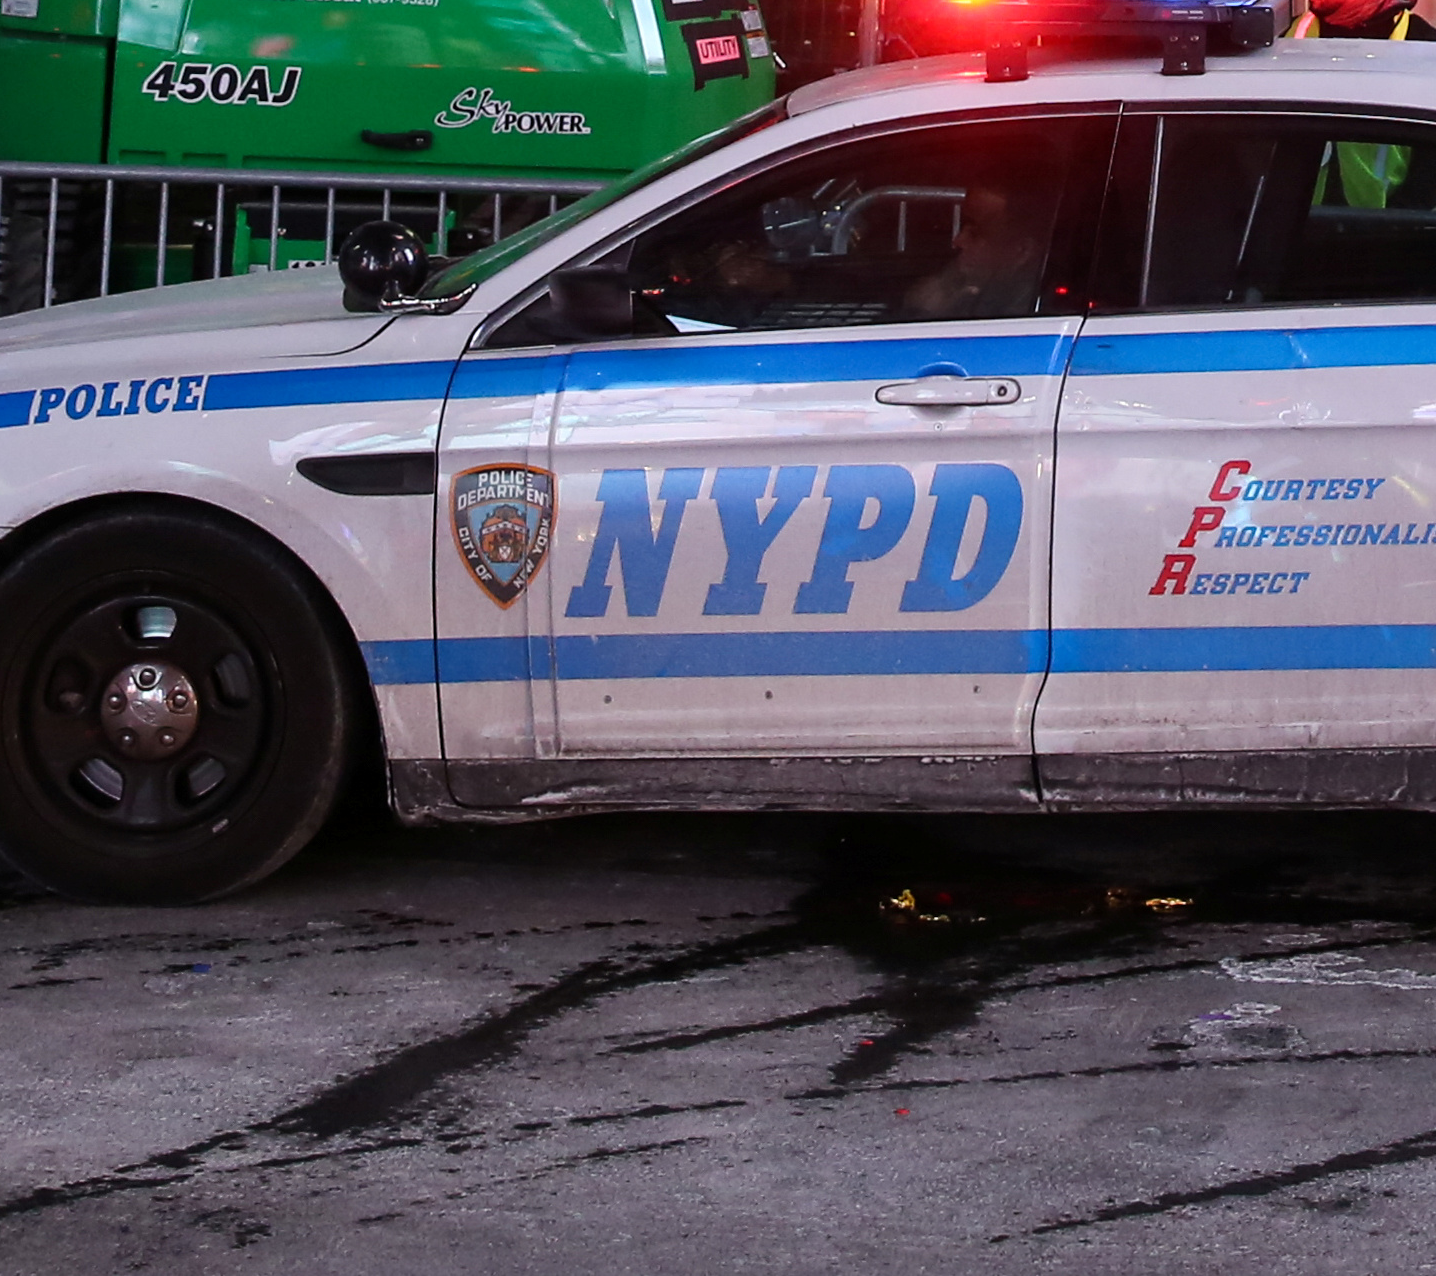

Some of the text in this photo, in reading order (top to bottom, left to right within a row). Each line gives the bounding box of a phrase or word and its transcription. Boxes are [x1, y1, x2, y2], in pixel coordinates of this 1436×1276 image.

[700, 38, 738, 60] UTILITY
[142, 59, 302, 107] 450AJ
[33, 376, 207, 423] POLICE
[457, 483, 552, 512] DEPARTMENT
[478, 469, 534, 488] POLICE
[1209, 460, 1386, 503] COURTESY
[458, 517, 552, 589] CITY OF NEW YORK
[564, 463, 1026, 619] NYPD
[1149, 554, 1310, 597] RESPECT
